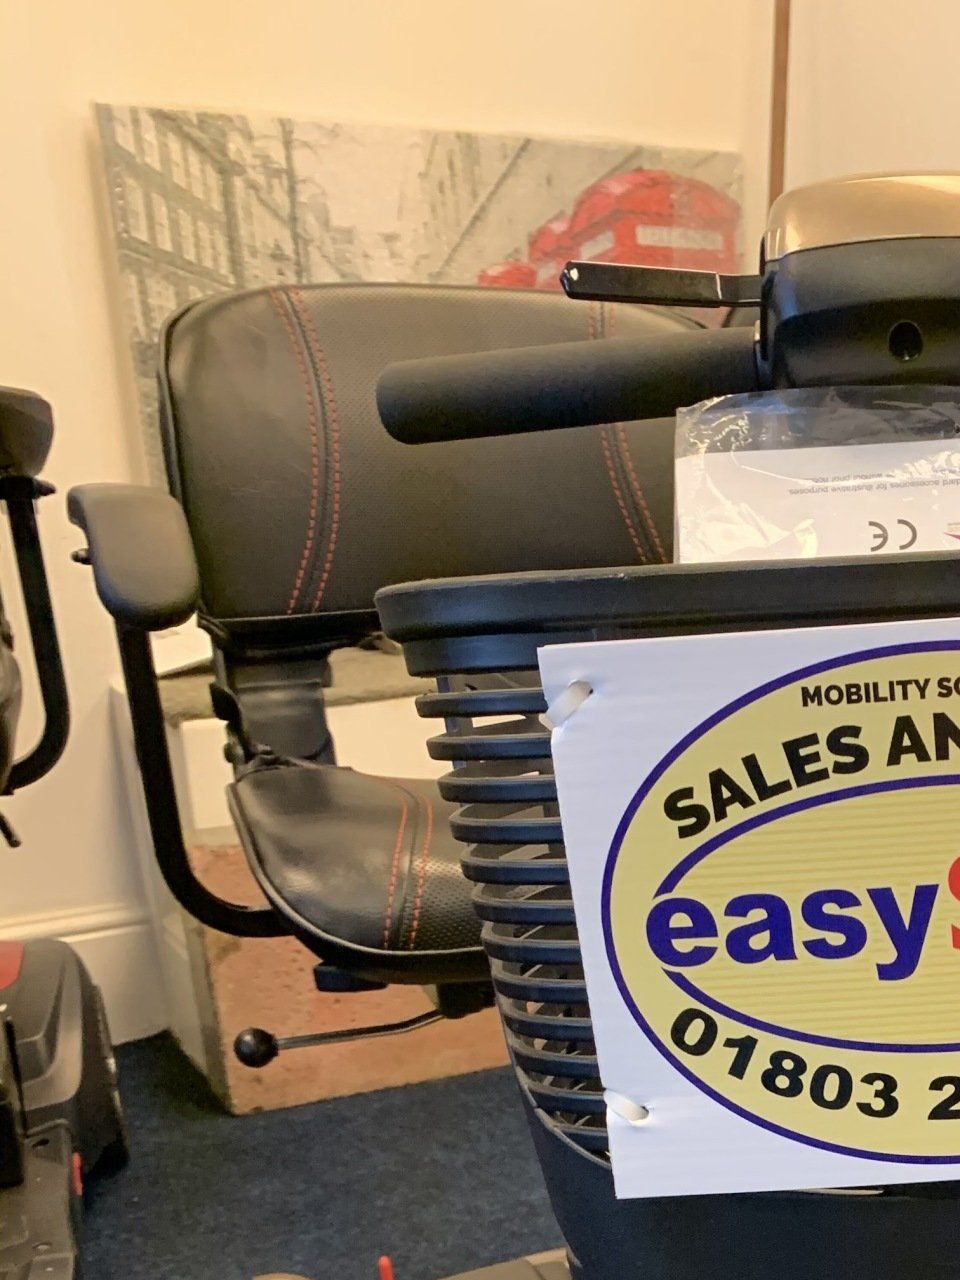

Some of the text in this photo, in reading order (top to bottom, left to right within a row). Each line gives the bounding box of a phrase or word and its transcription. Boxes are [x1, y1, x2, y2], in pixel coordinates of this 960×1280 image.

[875, 482, 887, 491] for
[800, 676, 930, 708] MOBILITY
[663, 725, 870, 839] SALES
[668, 1007, 900, 1119] 01803
